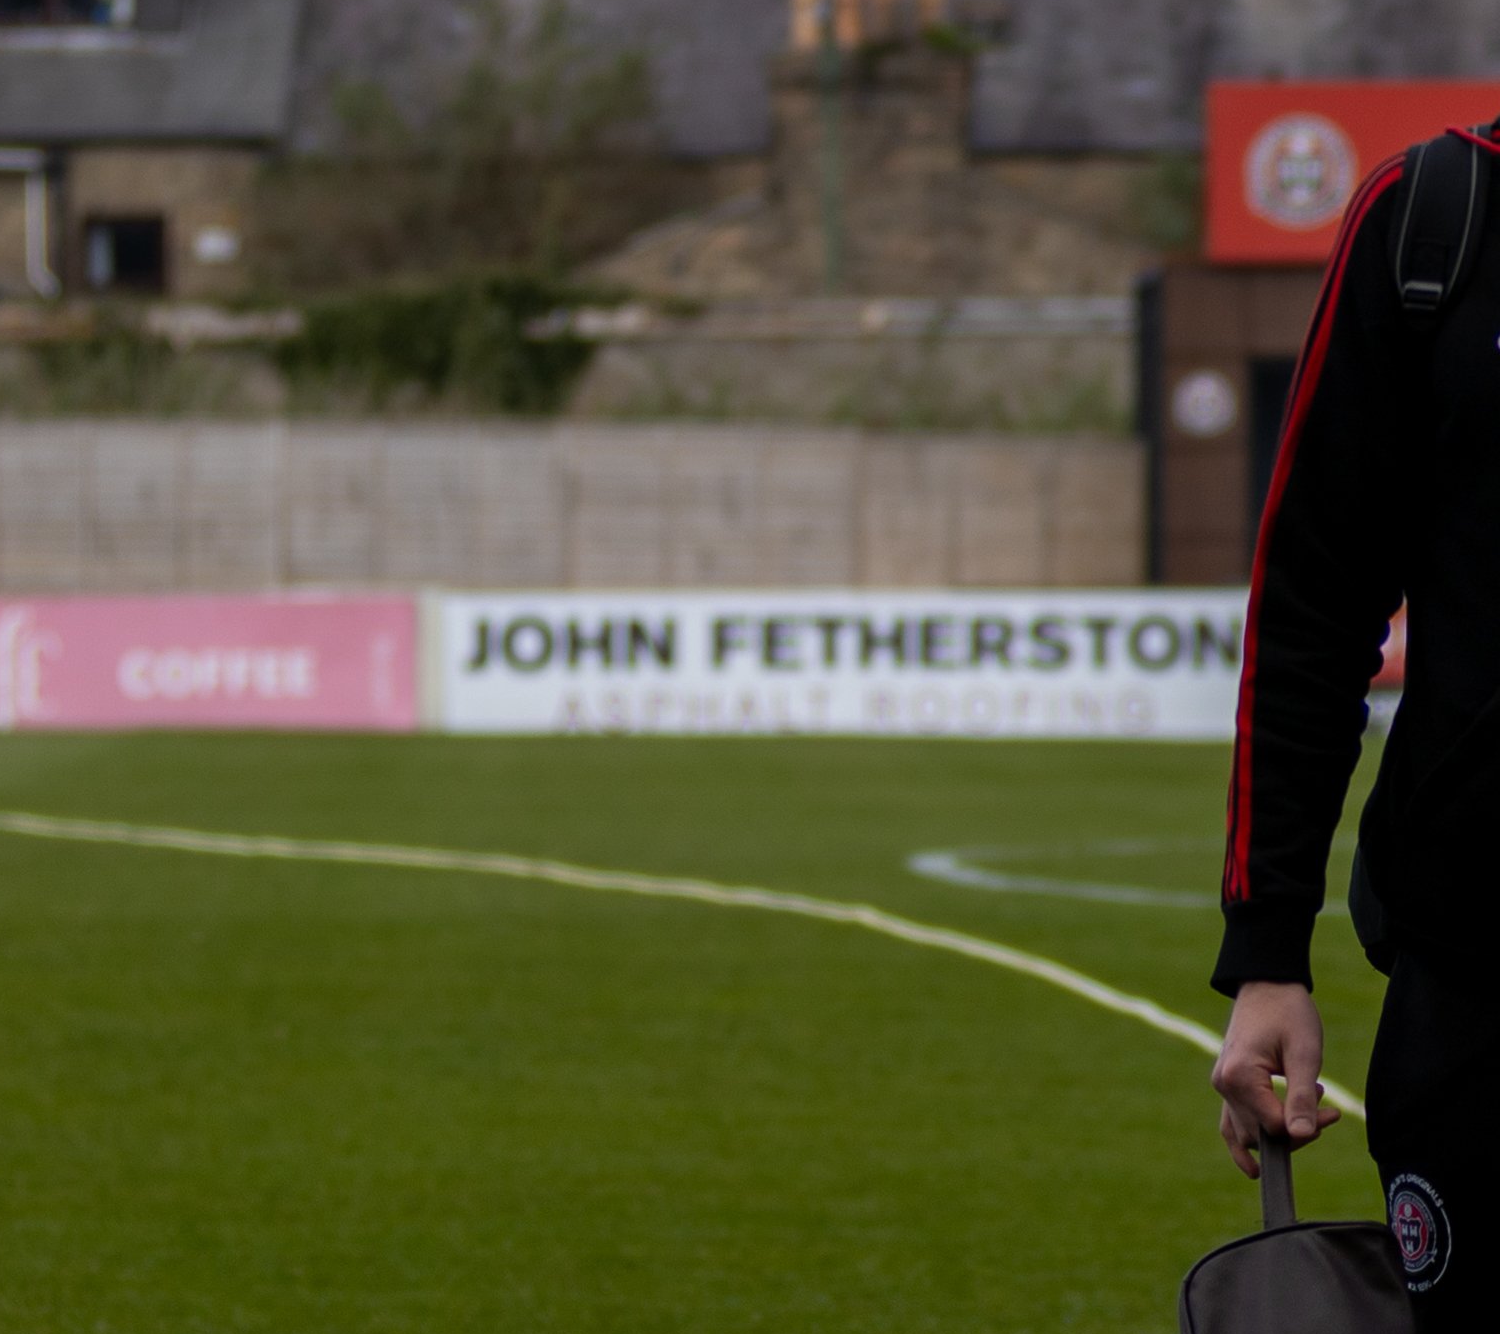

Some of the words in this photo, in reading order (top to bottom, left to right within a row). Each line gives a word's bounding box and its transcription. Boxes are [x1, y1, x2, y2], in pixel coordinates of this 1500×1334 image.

[468, 616, 677, 673] JOHN
[710, 614, 1242, 673] FETHERSTON
[117, 647, 317, 702] COFFEE
